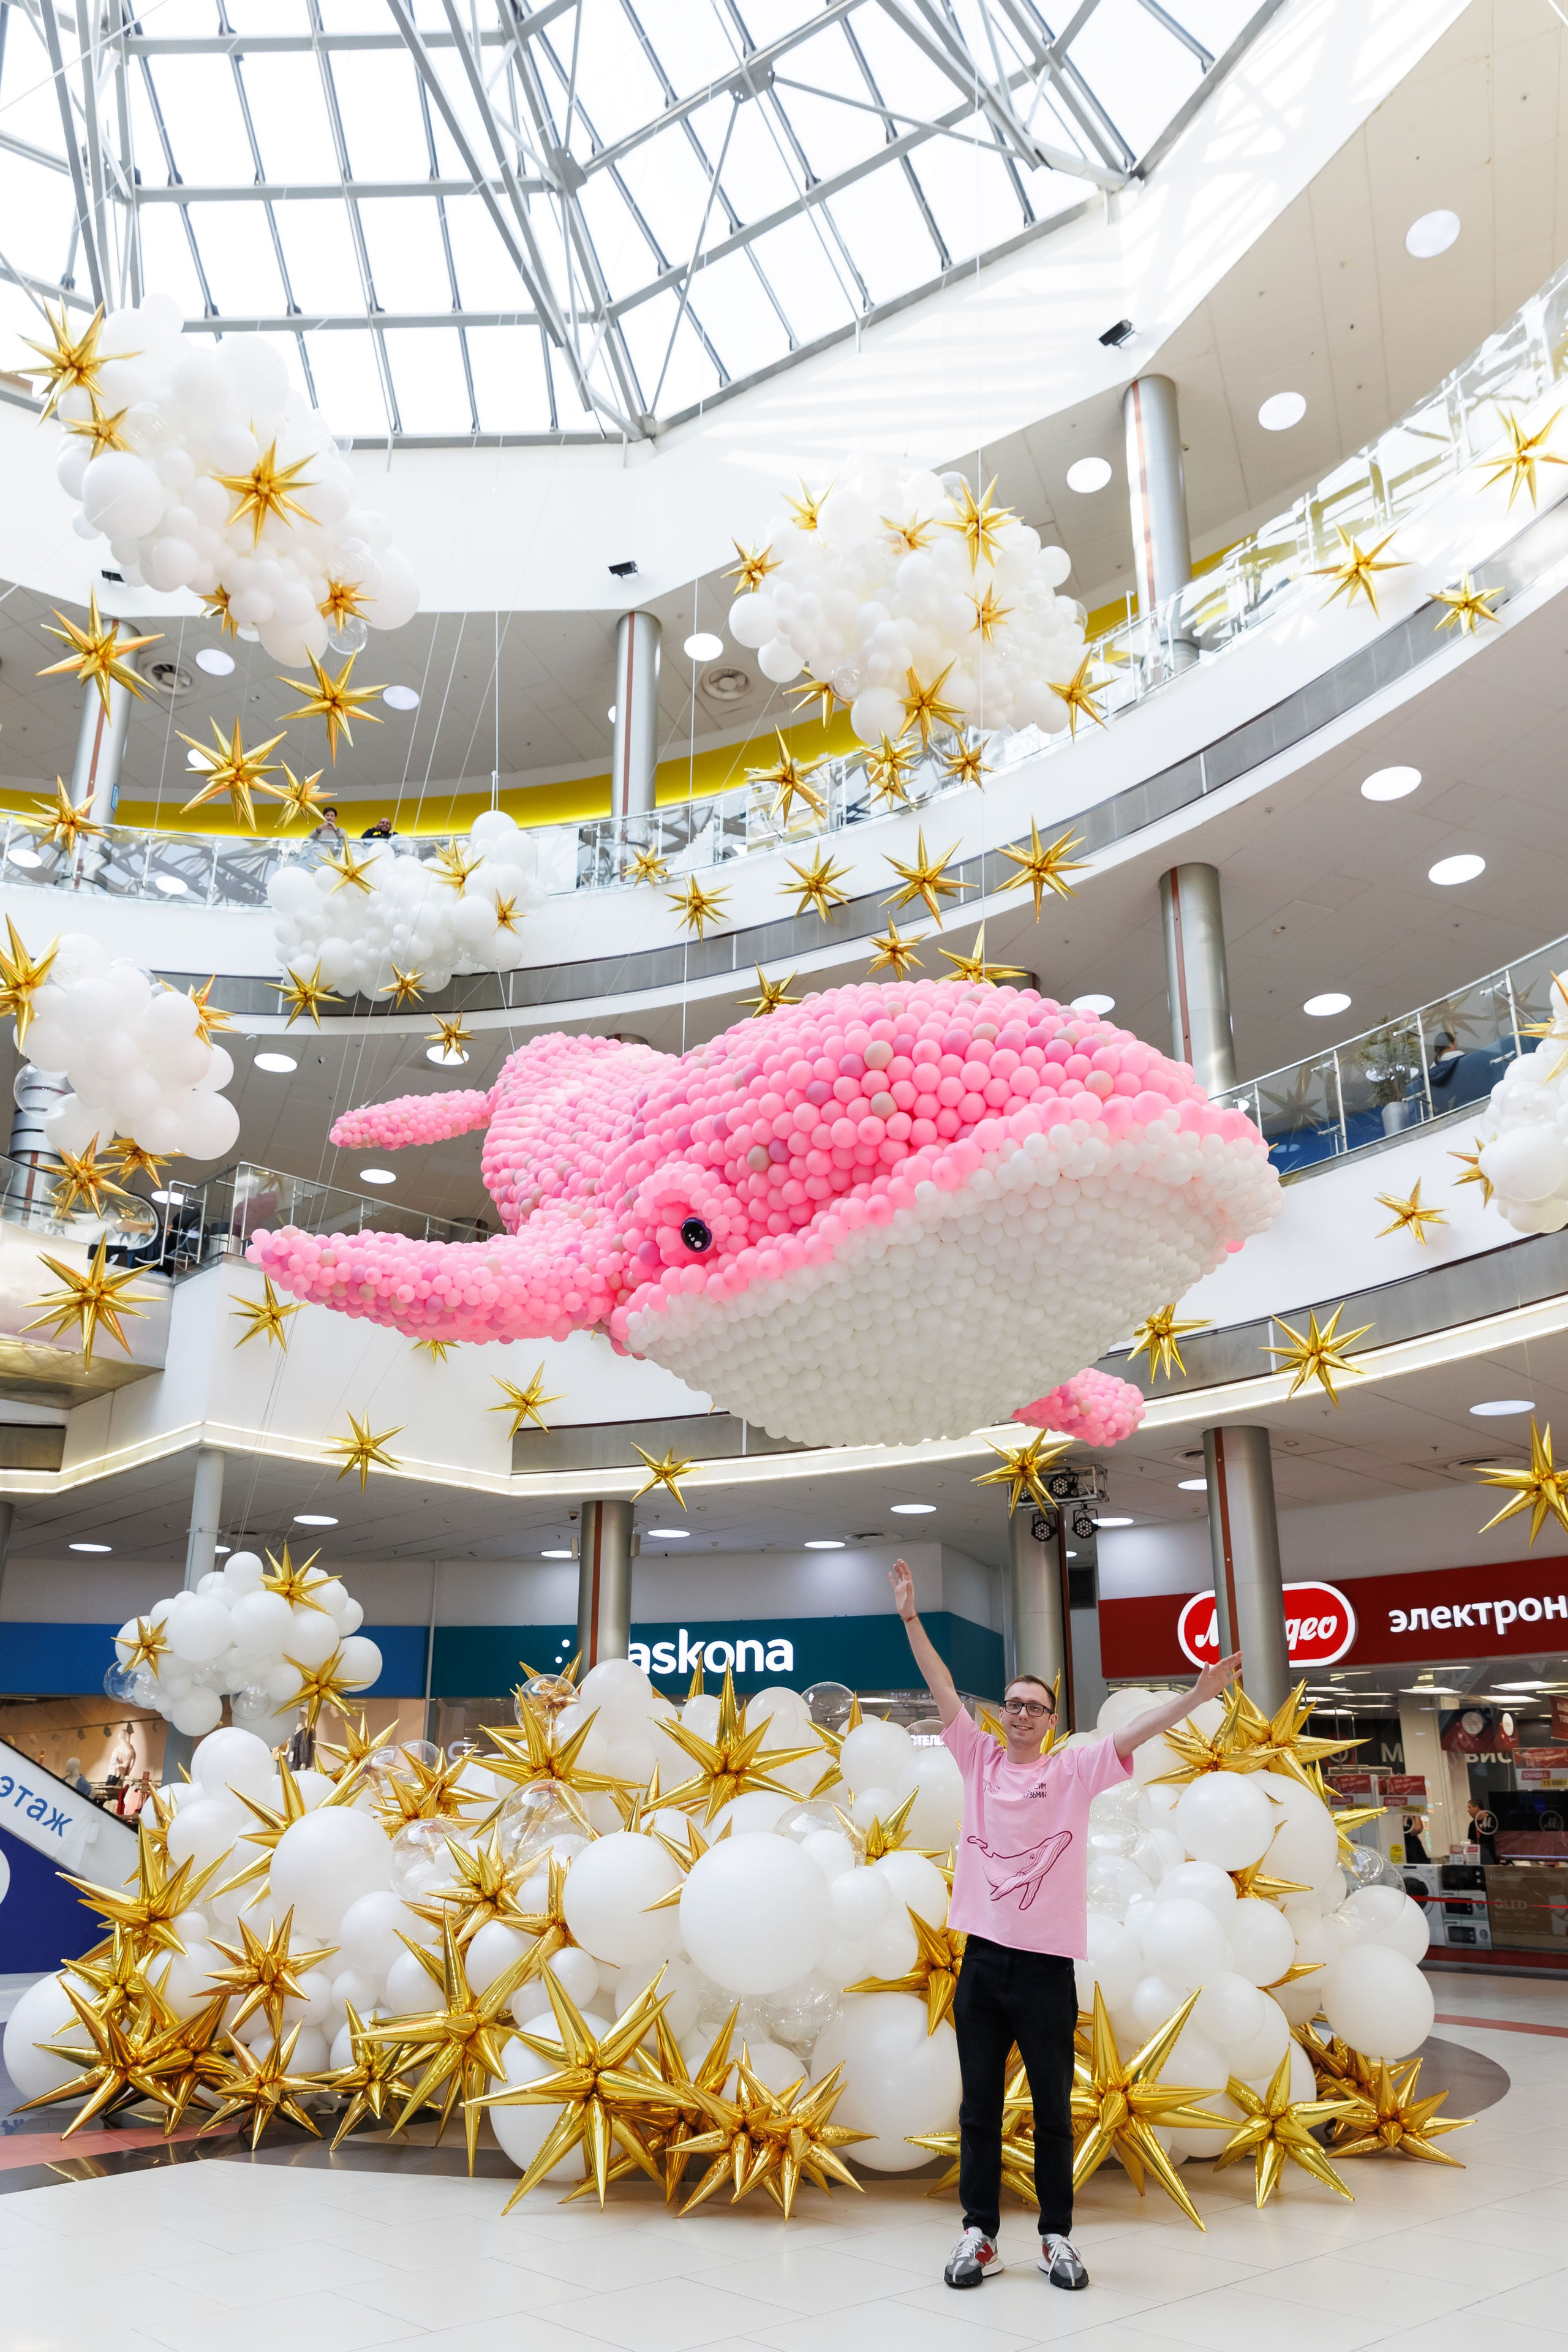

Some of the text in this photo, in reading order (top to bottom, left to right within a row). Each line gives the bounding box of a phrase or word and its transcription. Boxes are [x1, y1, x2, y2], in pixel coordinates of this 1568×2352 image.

[1389, 1595, 1568, 1635] электрон
[628, 1629, 793, 1675] askona
[0, 1776, 74, 1837] этаж
